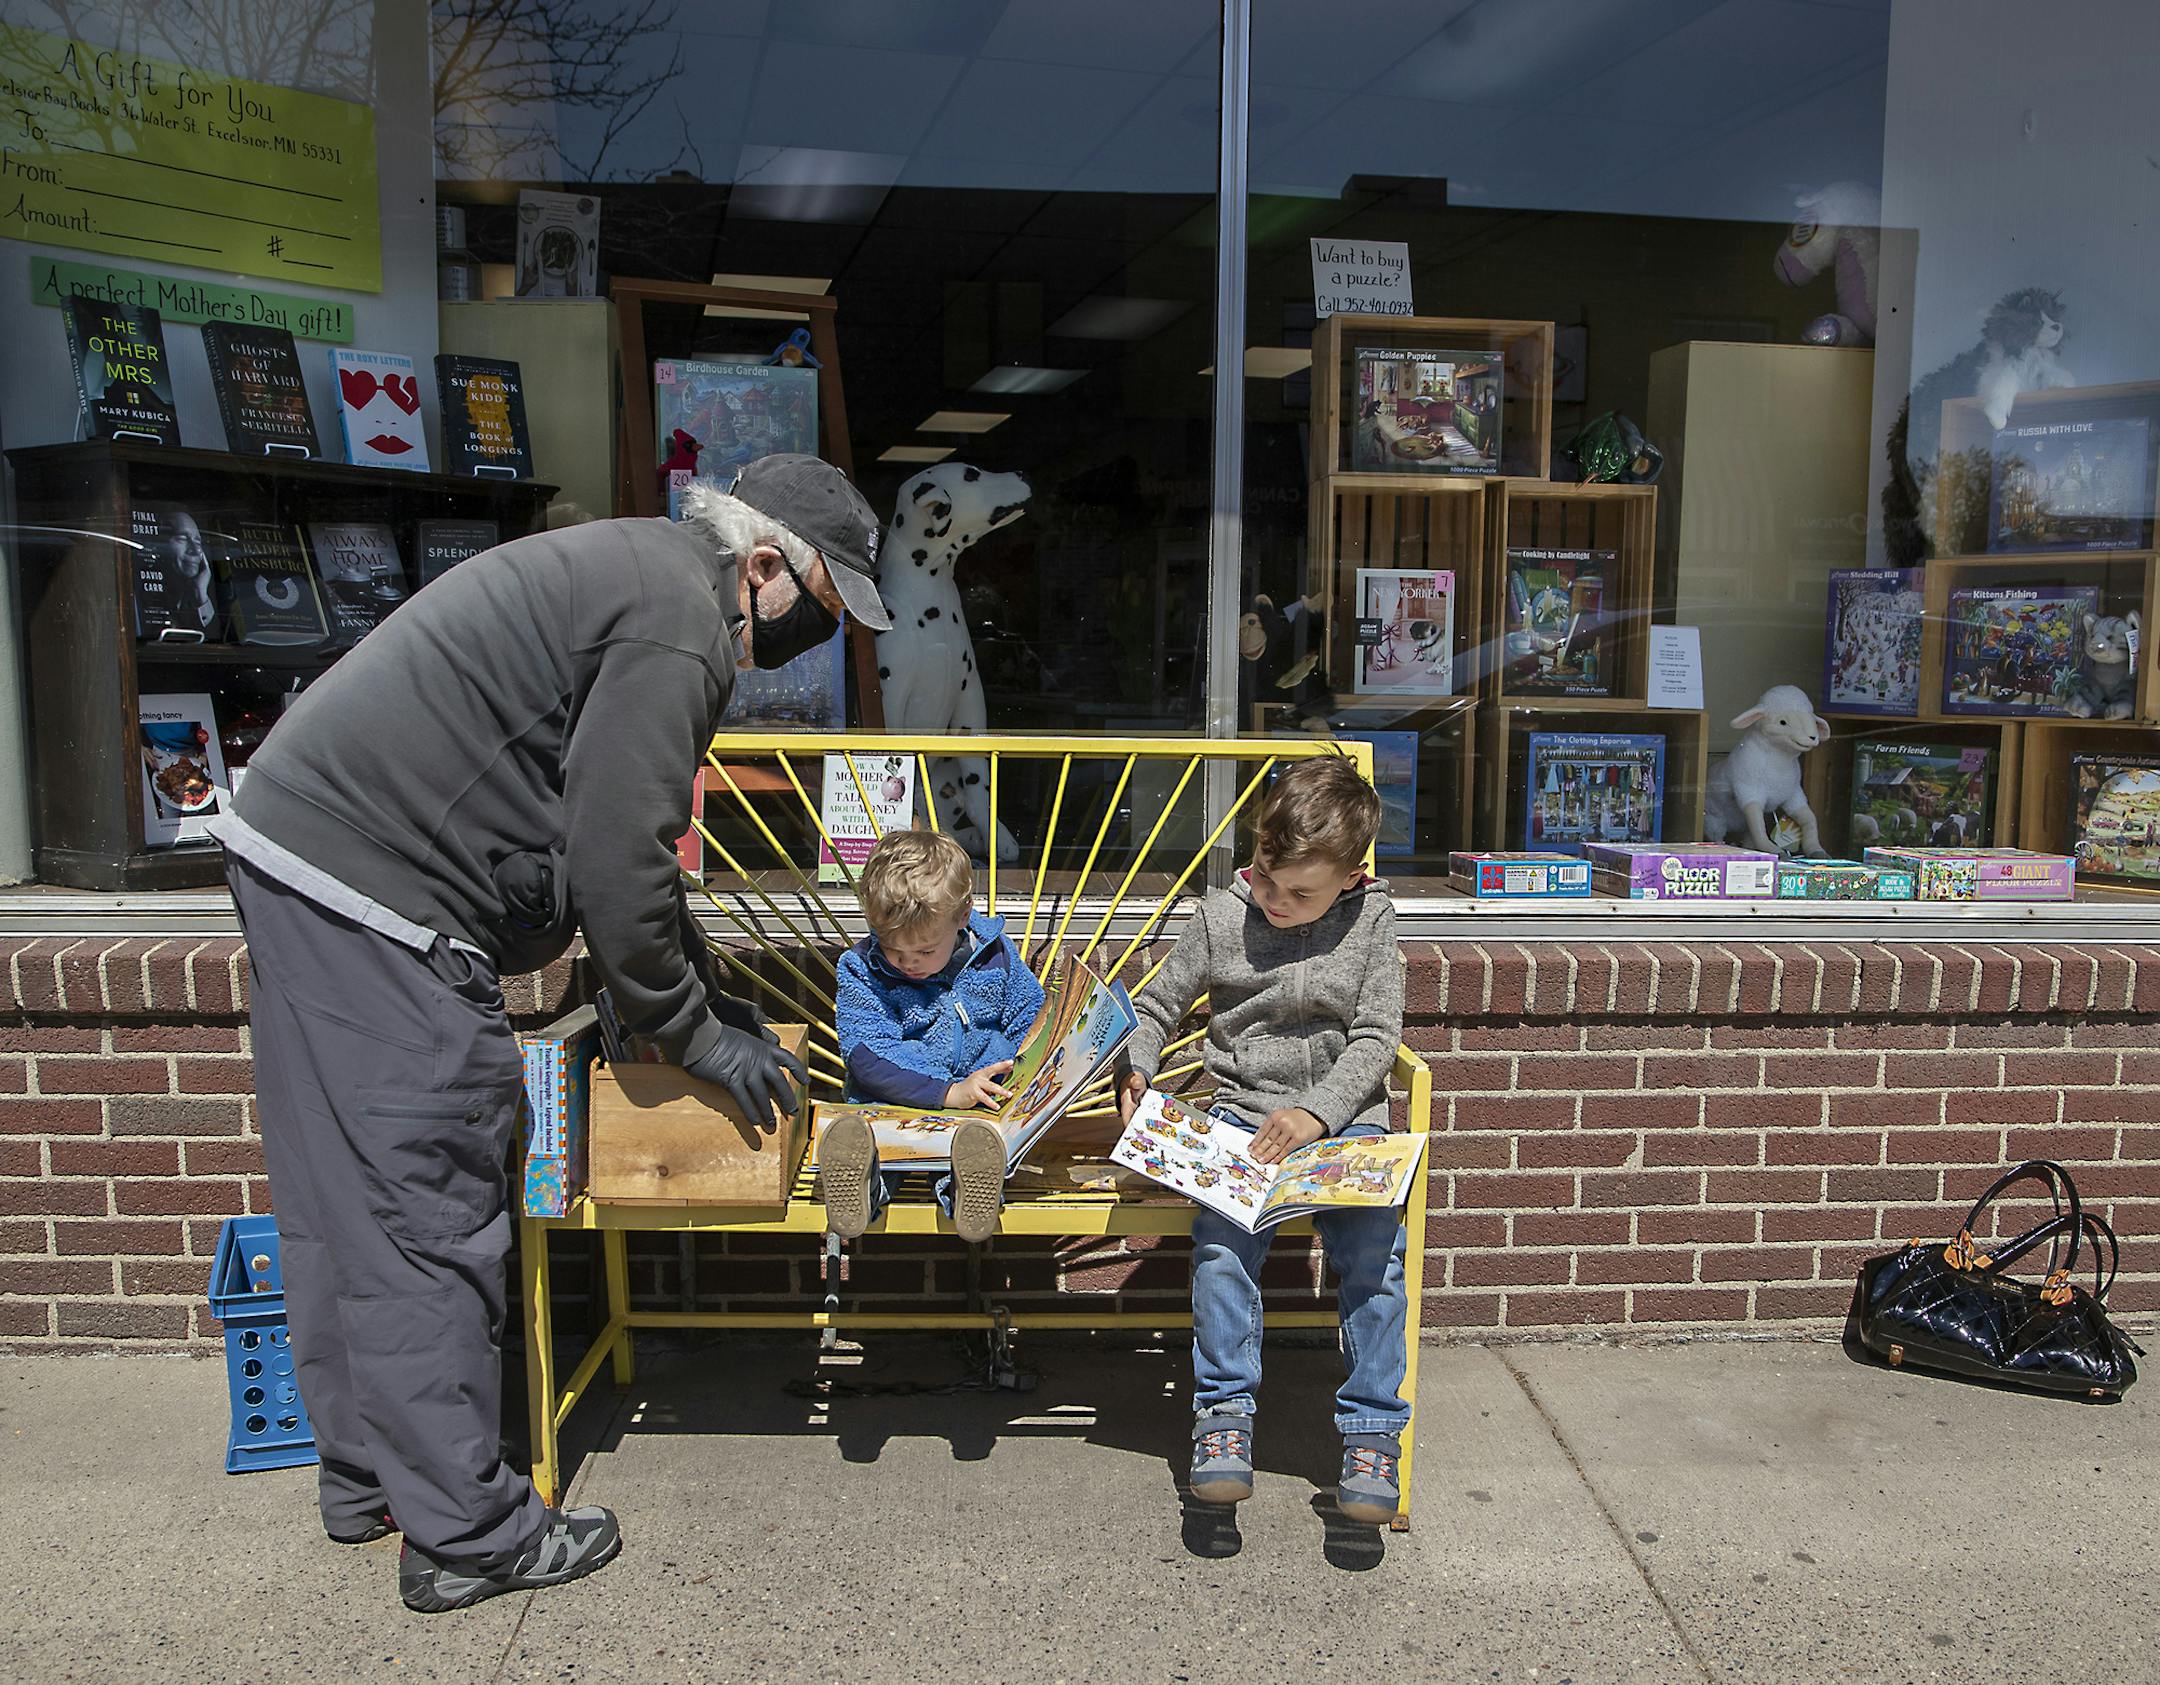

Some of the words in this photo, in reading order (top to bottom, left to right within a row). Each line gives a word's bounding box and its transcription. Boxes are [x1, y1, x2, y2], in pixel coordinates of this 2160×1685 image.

[55, 43, 81, 81] A
[96, 52, 158, 98] Gift
[174, 72, 214, 110] for
[226, 84, 275, 124] You
[0, 79, 41, 101] elsior
[44, 86, 68, 110] Bay
[70, 91, 110, 116] Books
[274, 137, 296, 155] MN
[303, 142, 342, 165] 55331
[13, 109, 49, 143] To:
[2, 146, 64, 186] From:
[4, 193, 97, 234] Amount:
[1316, 243, 1356, 264] Want
[1362, 250, 1373, 265] to
[1378, 250, 1403, 271] buy
[1332, 272, 1341, 284] a
[1347, 272, 1400, 288] puzzle?
[43, 265, 64, 298] A
[70, 274, 146, 305] perfect
[158, 280, 246, 320] Mother's
[251, 294, 288, 330] Day
[299, 304, 342, 336] gift!
[1318, 295, 1339, 312] Call
[102, 317, 137, 335] THE
[88, 336, 160, 362] OTHER
[230, 343, 287, 359] GHOSTS
[339, 352, 355, 362] THE
[358, 354, 379, 365] ROXY
[380, 356, 412, 369] LETTERS
[1380, 351, 1404, 360] Golden
[1407, 352, 1437, 362] Puppies
[253, 359, 271, 371] OF
[686, 363, 733, 375] Birdhouse
[736, 366, 769, 377] Garden
[105, 361, 157, 385] MRS.
[231, 370, 300, 387] HARVARD
[451, 378, 476, 388] SUE
[480, 381, 519, 393] MONK
[471, 392, 503, 403] KIDD
[99, 405, 129, 417] MARY
[132, 410, 171, 423] KUBICA
[480, 420, 502, 430] THE
[2018, 426, 2047, 437] RUSSIA
[2050, 424, 2071, 434] WITH
[2072, 423, 2094, 432] LOVE
[470, 432, 501, 442] BOOK
[464, 444, 523, 456] LONGINGS
[673, 473, 689, 486] 20
[132, 510, 156, 522] FINAL
[132, 525, 160, 536] DRAFT
[242, 528, 284, 543] RUTH
[322, 535, 388, 548] ALWAYS
[332, 552, 387, 566] HOME
[428, 547, 484, 559] SPLEND
[1522, 550, 1547, 560] Cooking
[1548, 551, 1555, 559] by
[1556, 551, 1590, 560] Candlelight
[232, 557, 308, 573] GINSBURG
[140, 571, 164, 581] DAVID
[1850, 571, 1883, 579] Sledding
[143, 583, 165, 593] CARR
[1400, 588, 1440, 599] YORKER
[1973, 590, 2004, 599] Kittens
[2006, 590, 2038, 600] Fishing
[139, 711, 162, 721] othing
[1553, 736, 1566, 744] The
[1568, 736, 1598, 746] Clothing
[1600, 736, 1631, 745] Emporium
[1876, 744, 1897, 753] Farm
[1898, 745, 1931, 756] Friends
[836, 771, 883, 782] MOHER
[832, 824, 894, 835] DAUGHER
[1674, 868, 1720, 882] FLOOR
[2000, 865, 2013, 876] 48
[2013, 865, 2051, 879] GIANT
[1665, 882, 1720, 896] PUZZLE
[1782, 875, 1796, 890] 30
